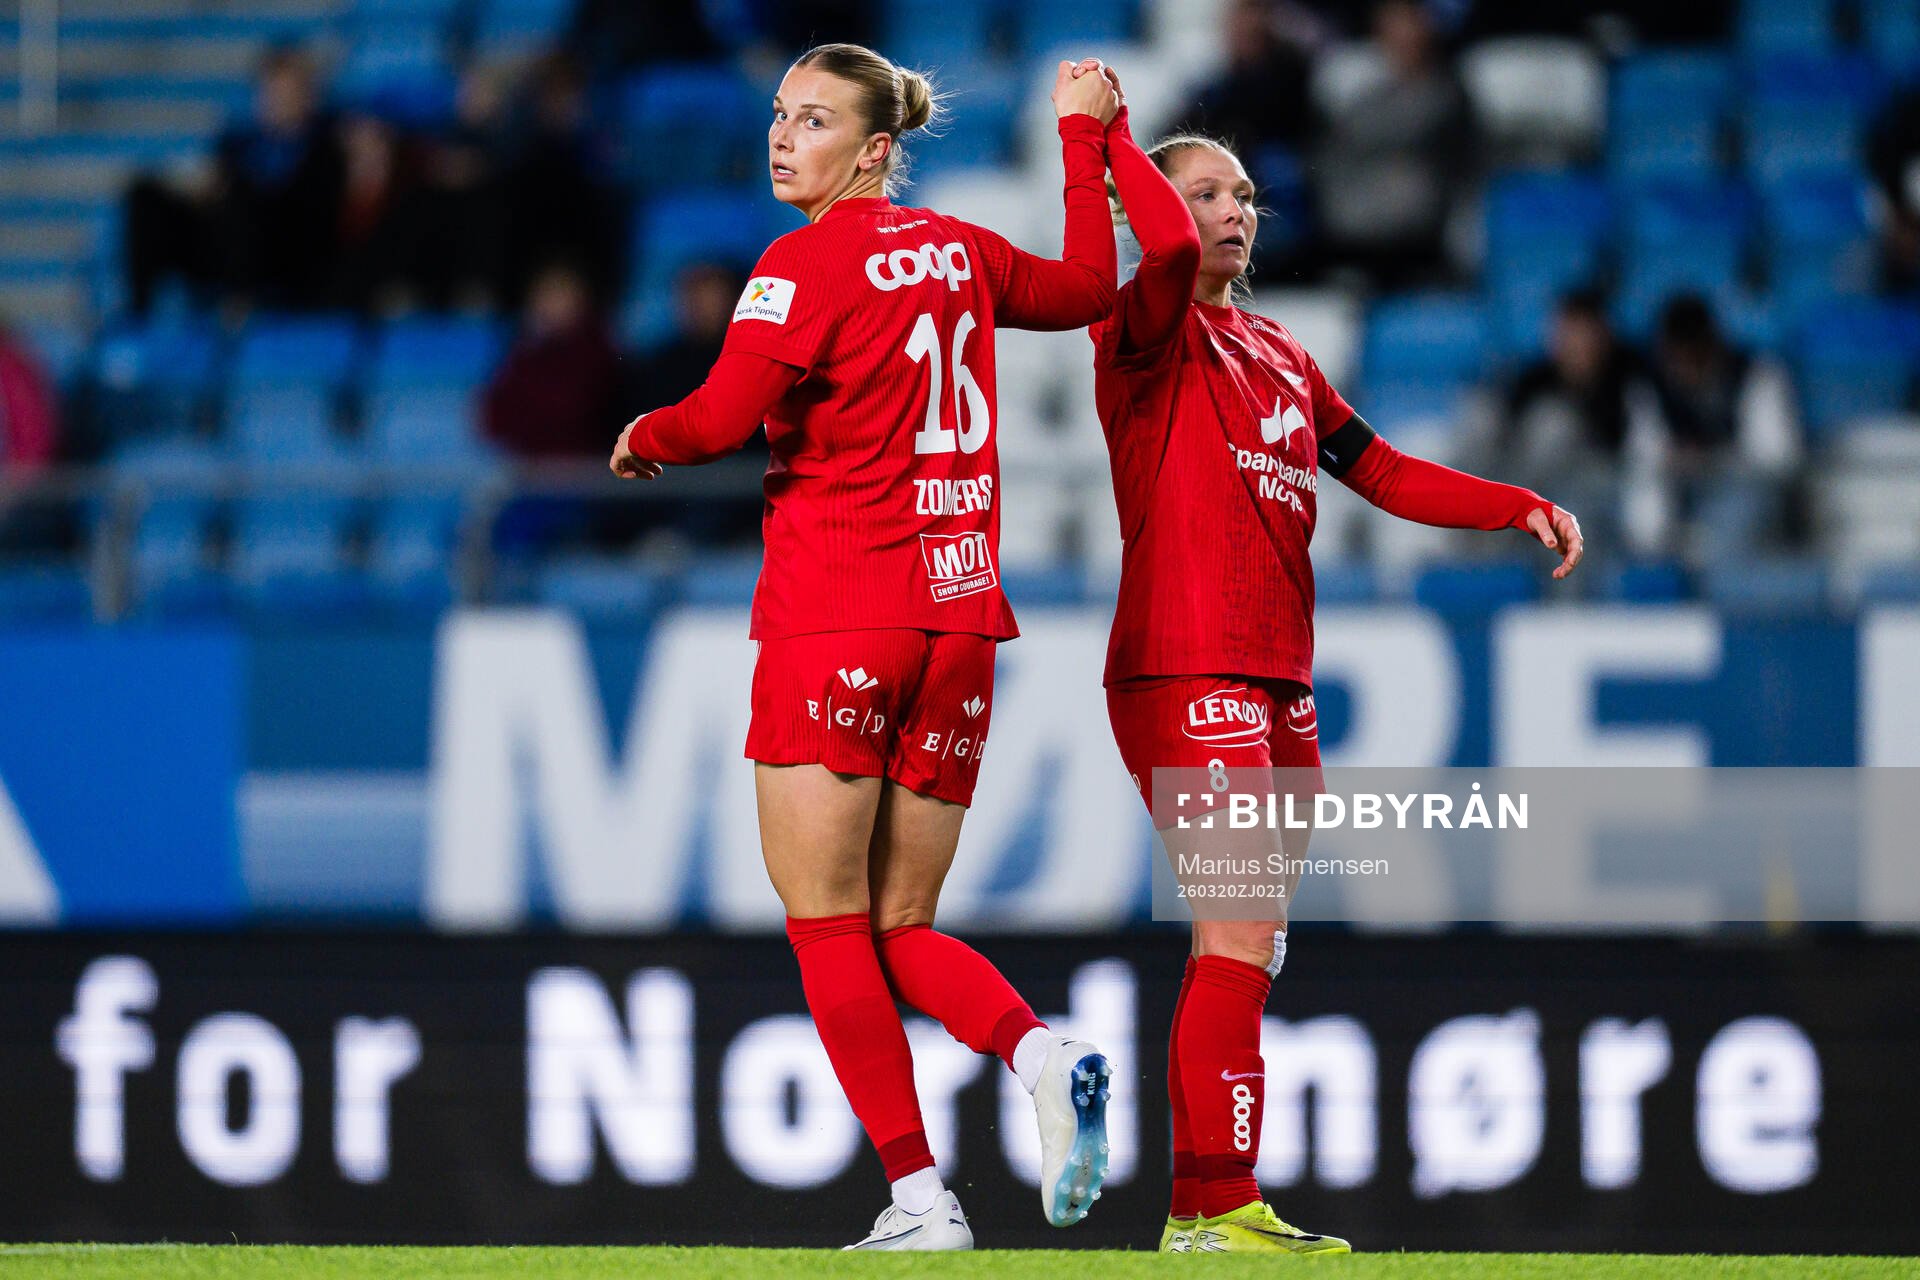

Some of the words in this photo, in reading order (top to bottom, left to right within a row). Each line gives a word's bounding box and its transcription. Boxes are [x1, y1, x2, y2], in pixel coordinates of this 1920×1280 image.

[865, 242, 971, 291] coop
[754, 306, 783, 319] Tipping
[904, 310, 990, 454] 16
[933, 533, 986, 578] MOT
[937, 585, 959, 597] SHOW
[959, 577, 990, 591] COURAGE!
[1188, 697, 1266, 728] LERØY
[425, 606, 1722, 931] MØRE
[1207, 758, 1230, 792] 8
[56, 954, 422, 1184] for
[1087, 1072, 1097, 1095] KING
[1232, 1084, 1255, 1152] coop
